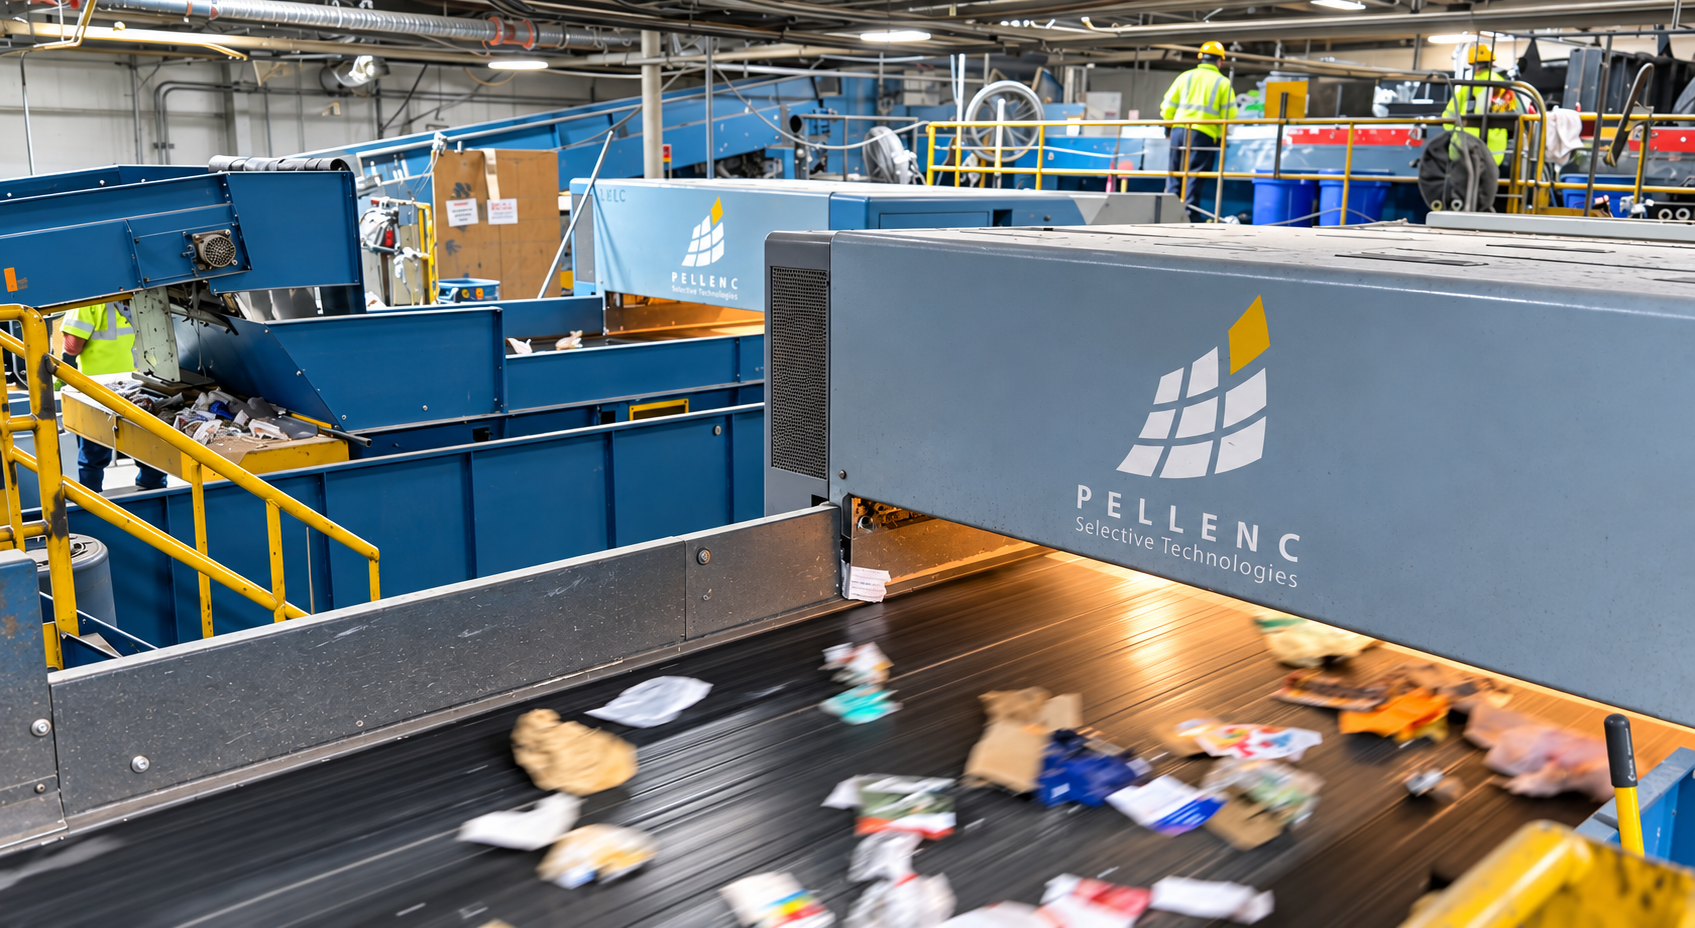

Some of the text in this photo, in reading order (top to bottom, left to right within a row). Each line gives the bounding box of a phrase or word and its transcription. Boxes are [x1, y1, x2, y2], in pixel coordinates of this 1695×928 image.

[671, 271, 738, 290] PELLENC
[698, 287, 738, 301] Technologies
[1076, 484, 1301, 563] PELLENC
[1075, 516, 1298, 588] Selective Technologies
